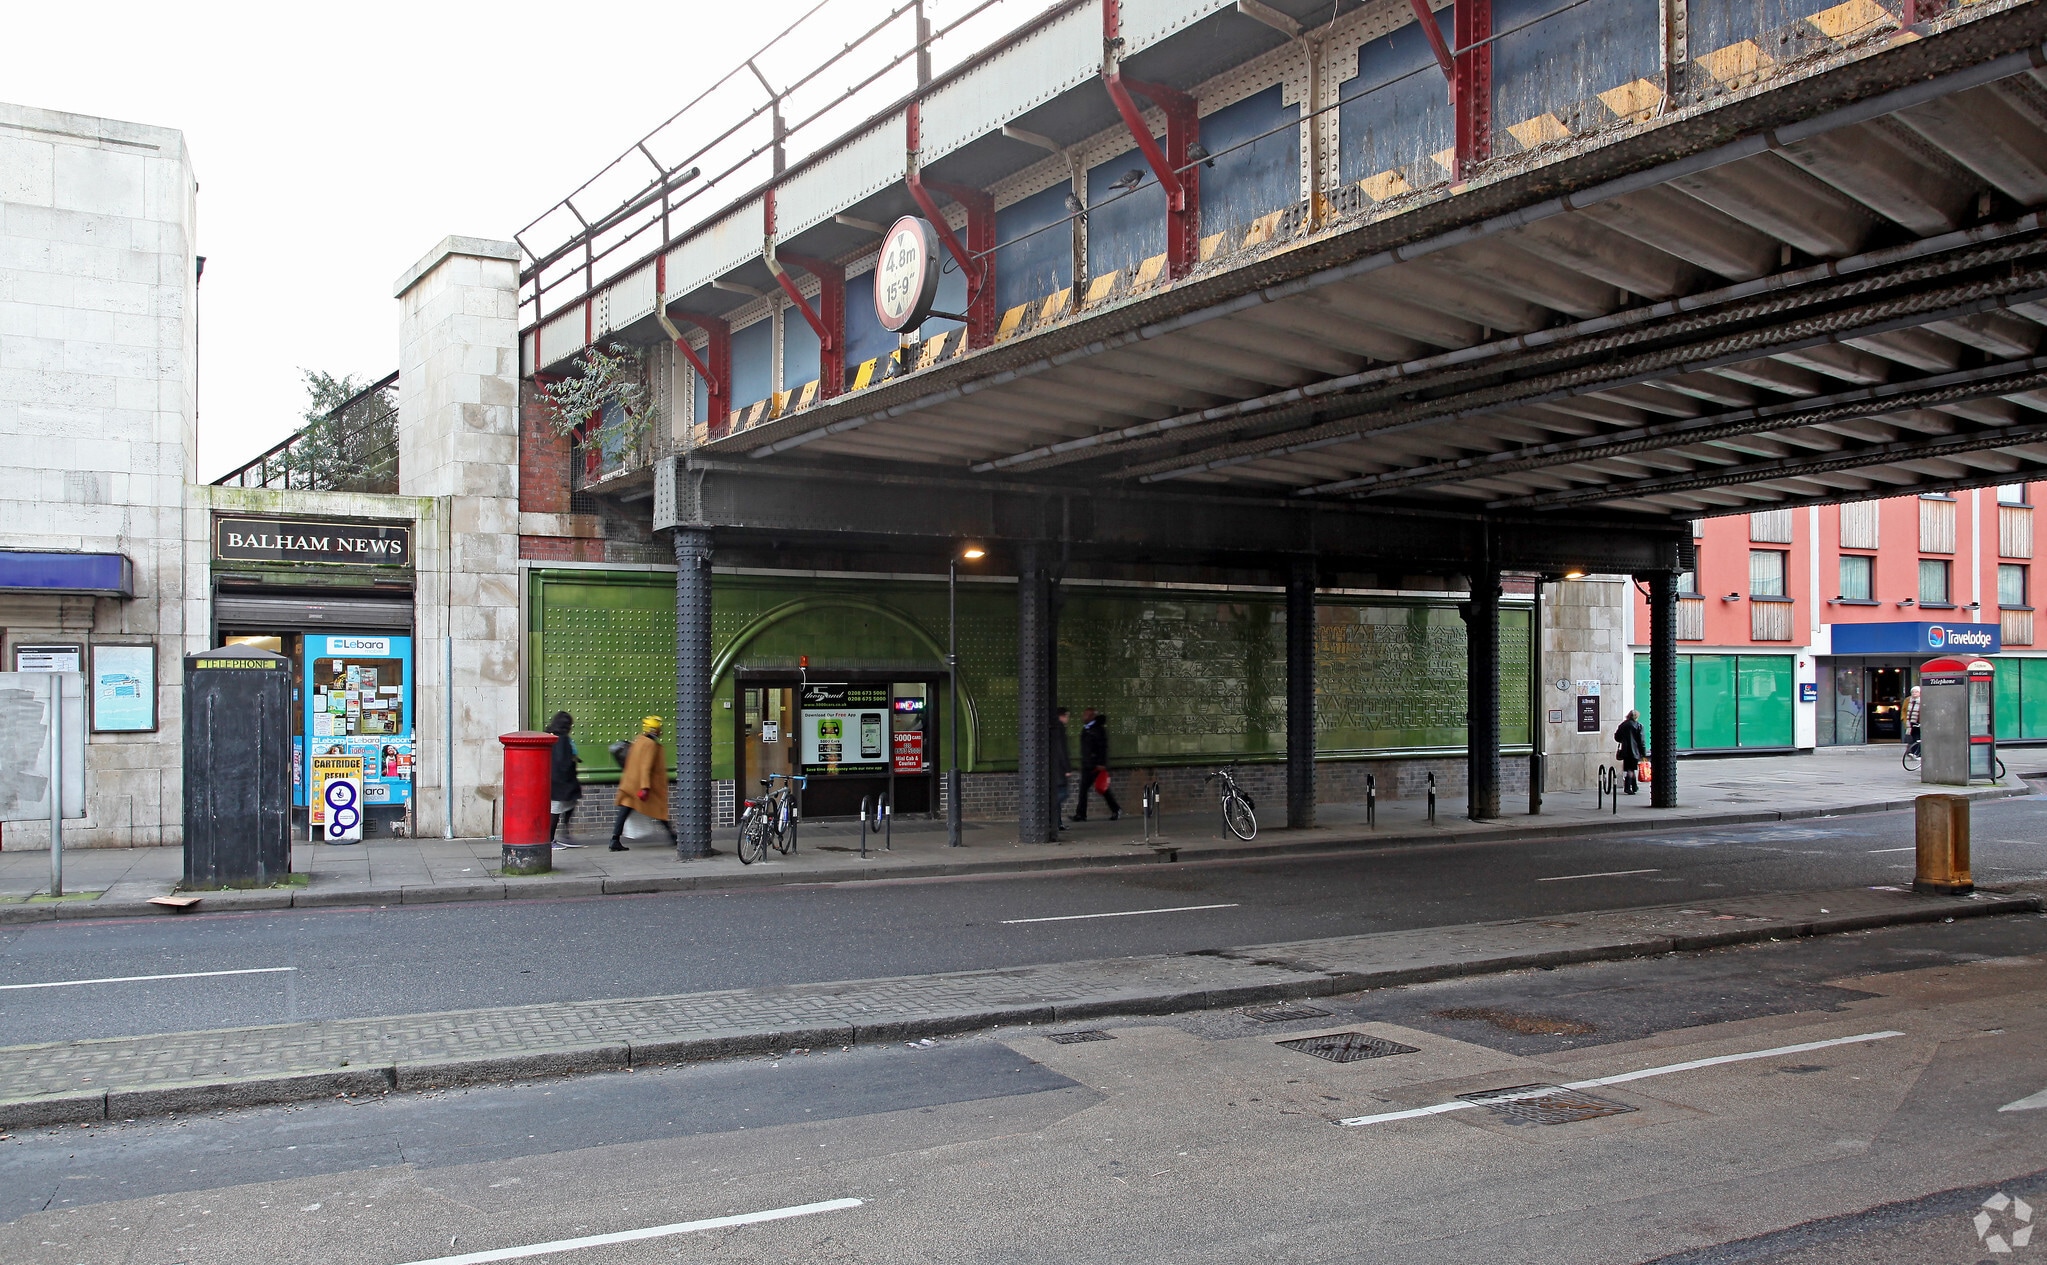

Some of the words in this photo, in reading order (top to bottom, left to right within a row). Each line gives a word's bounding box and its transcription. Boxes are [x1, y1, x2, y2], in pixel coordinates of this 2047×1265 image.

[886, 248, 916, 272] 4.8m
[228, 533, 330, 551] BALHAM
[337, 538, 402, 554] NEWS
[344, 640, 384, 649] Lebara
[1946, 629, 1992, 648] Travelodge
[205, 660, 269, 668] TELEPHONE
[314, 760, 360, 768] CARTRIDGE
